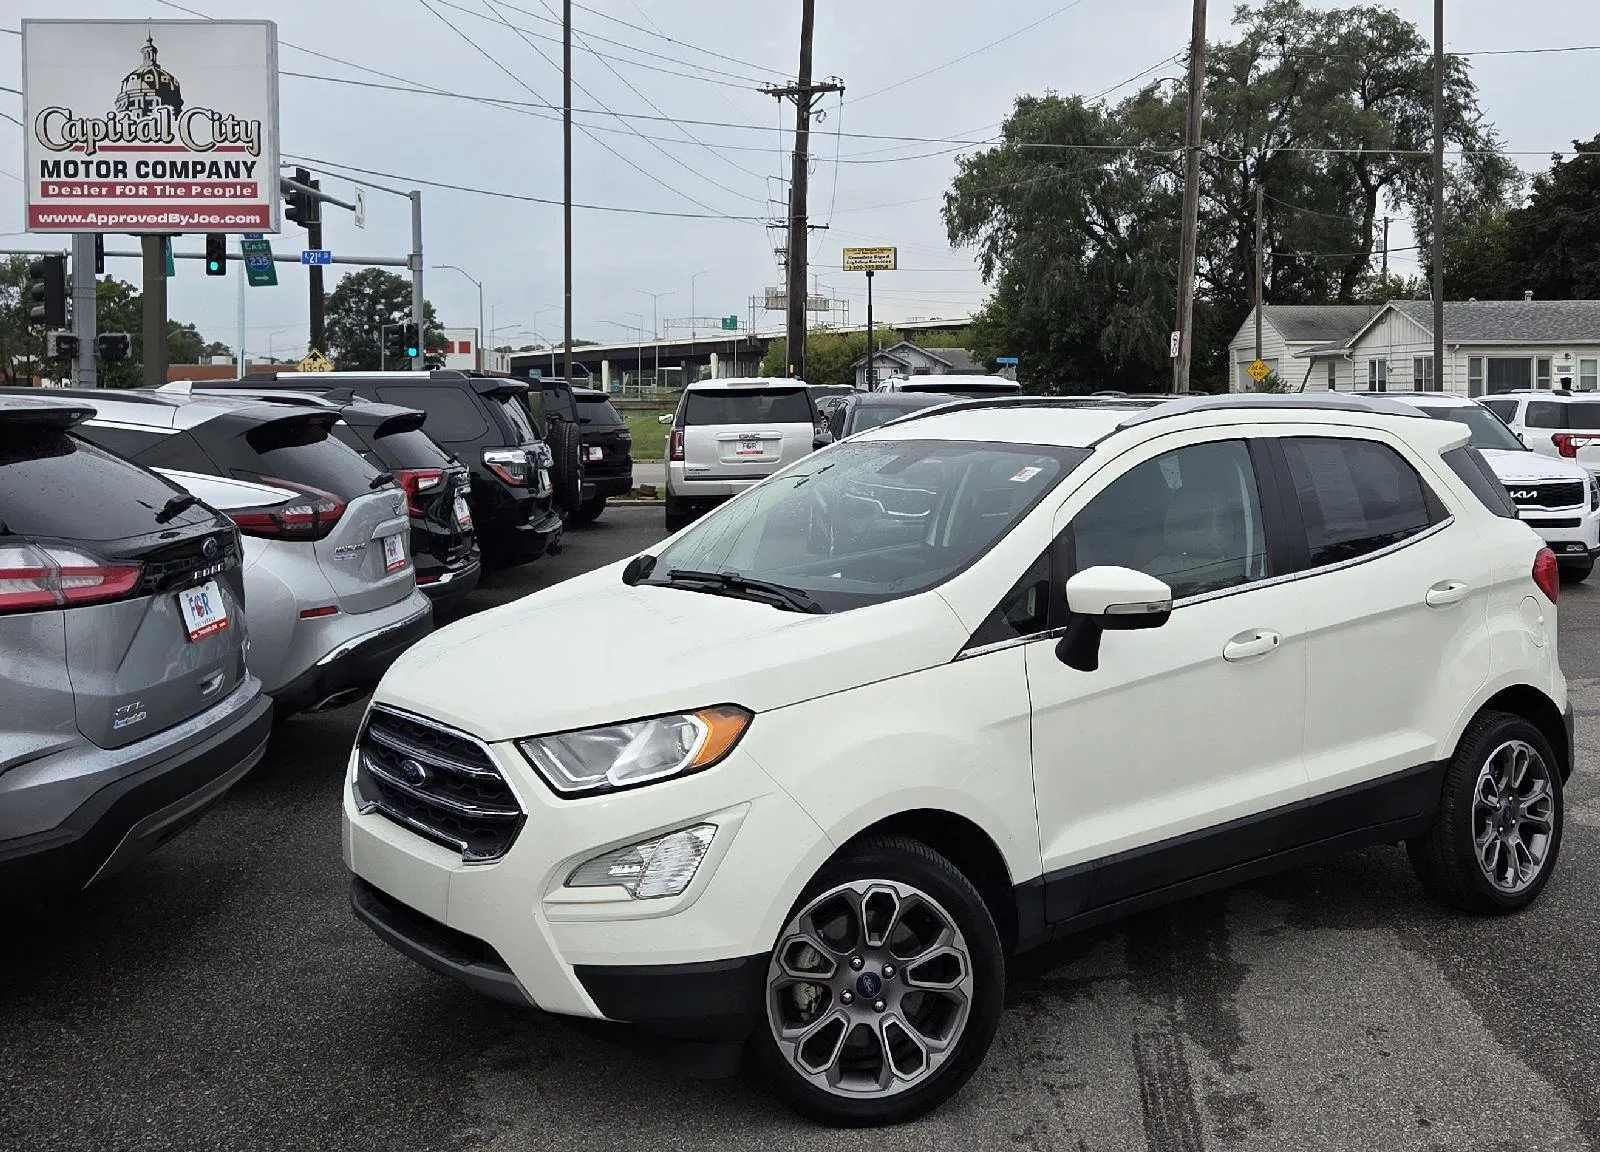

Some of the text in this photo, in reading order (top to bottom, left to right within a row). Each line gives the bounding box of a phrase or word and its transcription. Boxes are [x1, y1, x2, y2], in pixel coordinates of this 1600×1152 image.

[34, 106, 261, 156] Capital City
[40, 159, 257, 179] MOTOR COMPANY
[48, 184, 108, 196] Dealer
[115, 184, 148, 196] FOR
[154, 184, 186, 196] The
[38, 212, 261, 226] www.ApprovedByJoe.com
[250, 257, 268, 266] 235
[1510, 491, 1538, 499] KIA
